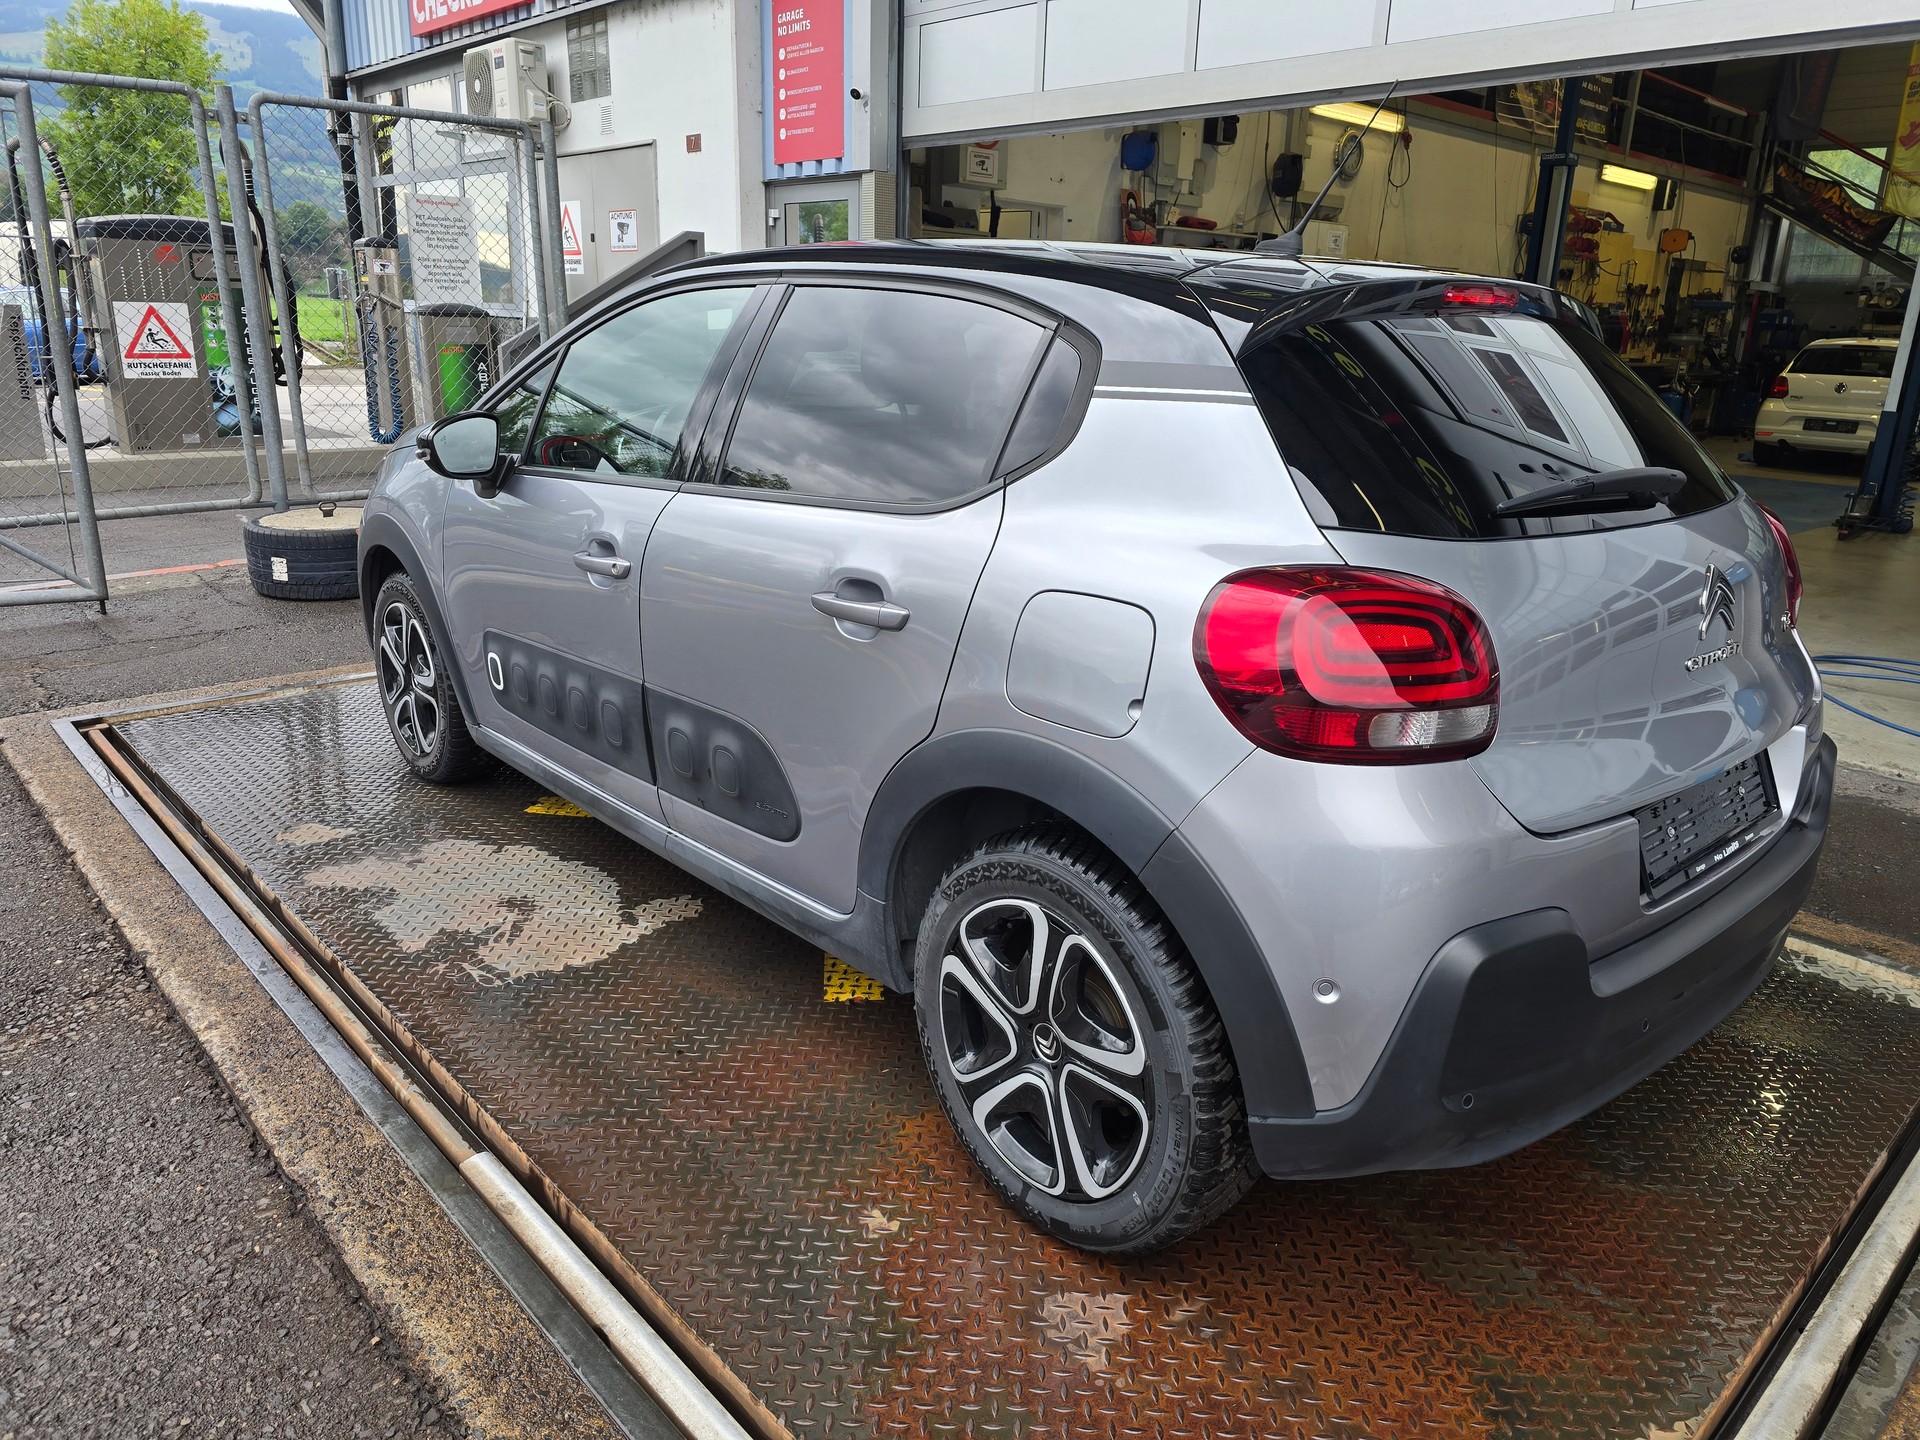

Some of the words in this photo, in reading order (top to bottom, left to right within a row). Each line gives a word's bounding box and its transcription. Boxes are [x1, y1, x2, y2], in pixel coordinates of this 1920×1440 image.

[777, 8, 804, 24] GARAGE
[777, 25, 787, 37] NO
[788, 20, 811, 34] LIMITS
[690, 136, 695, 149] 7
[611, 211, 633, 220] ACHTUNG
[1684, 639, 1741, 672] CITROËN
[1713, 853, 1723, 862] No
[1723, 840, 1740, 857] Limits
